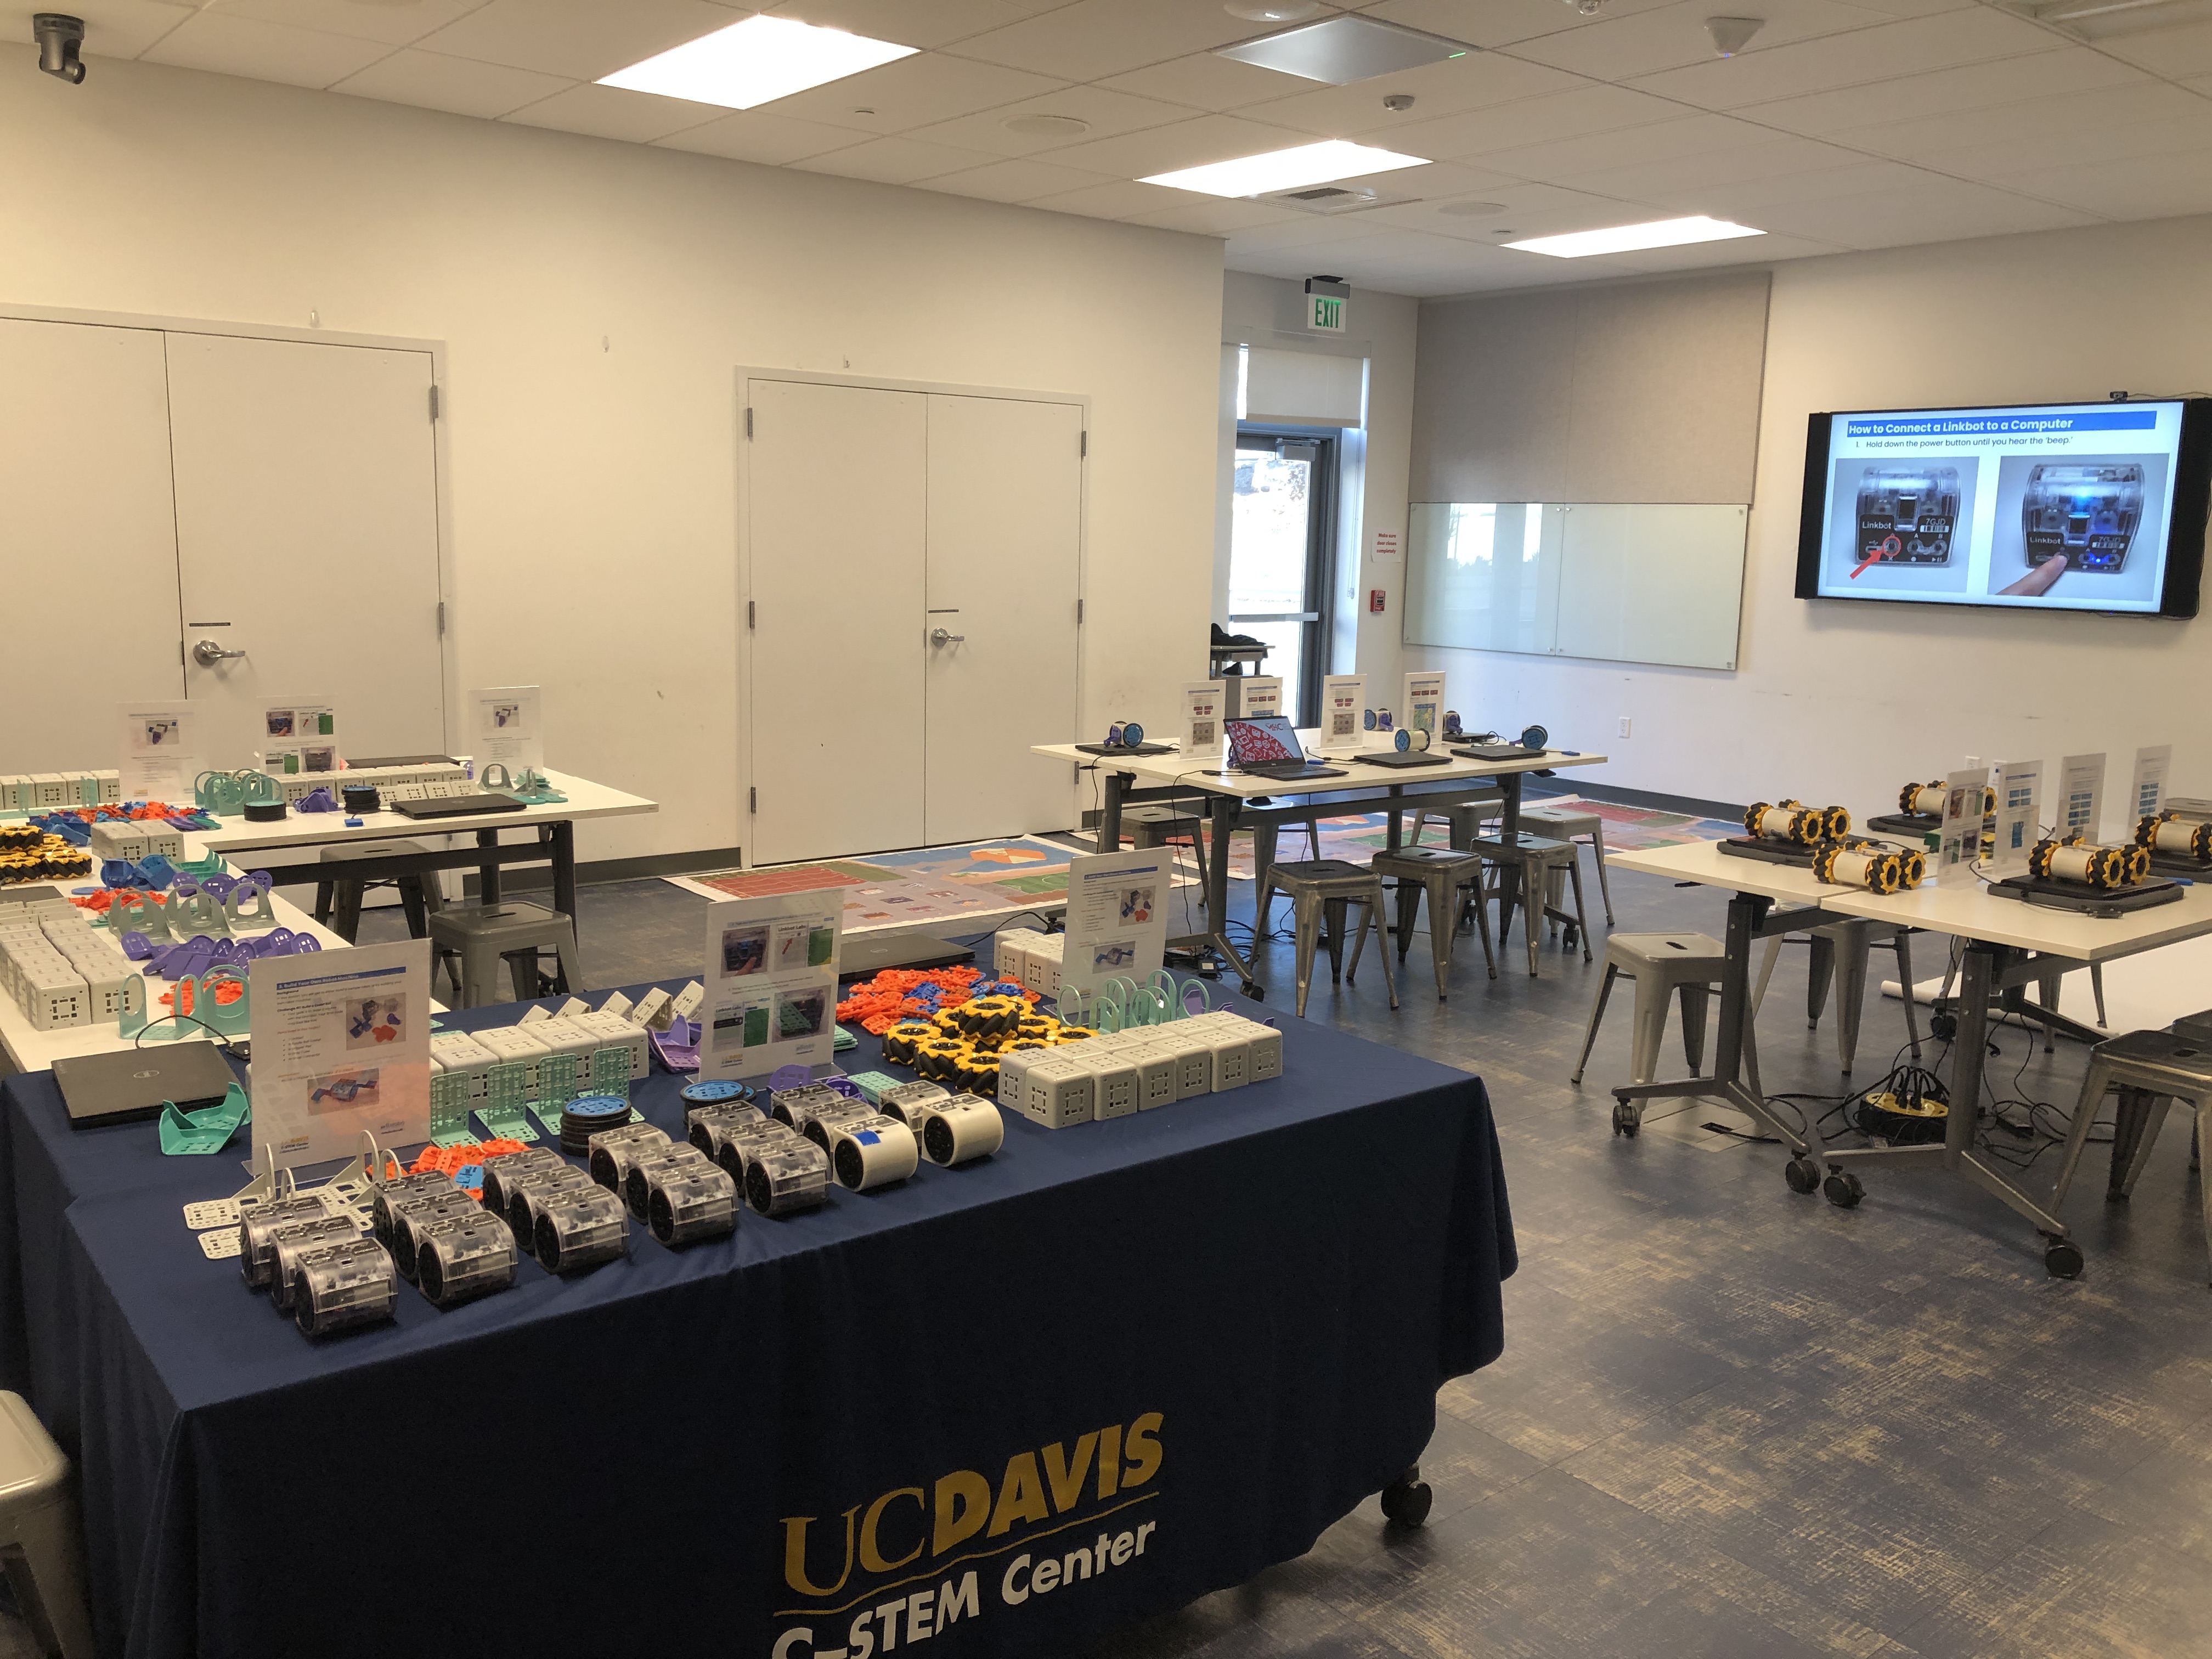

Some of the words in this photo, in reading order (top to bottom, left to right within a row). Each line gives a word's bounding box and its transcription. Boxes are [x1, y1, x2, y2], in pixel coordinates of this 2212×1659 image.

[1315, 298, 1341, 328] EXIT
[1849, 425, 1871, 434] How
[1873, 425, 1883, 433] to
[1886, 422, 1931, 433] Connect
[1943, 421, 1984, 432] Linkbot
[1987, 421, 1998, 430] to
[2011, 419, 2073, 432] Computer
[1920, 440, 1943, 448] power
[1992, 439, 2007, 447] you
[1862, 521, 1892, 529] Linkbot
[2030, 537, 2061, 545] Linkbot
[1001, 1521, 1156, 1606] Center
